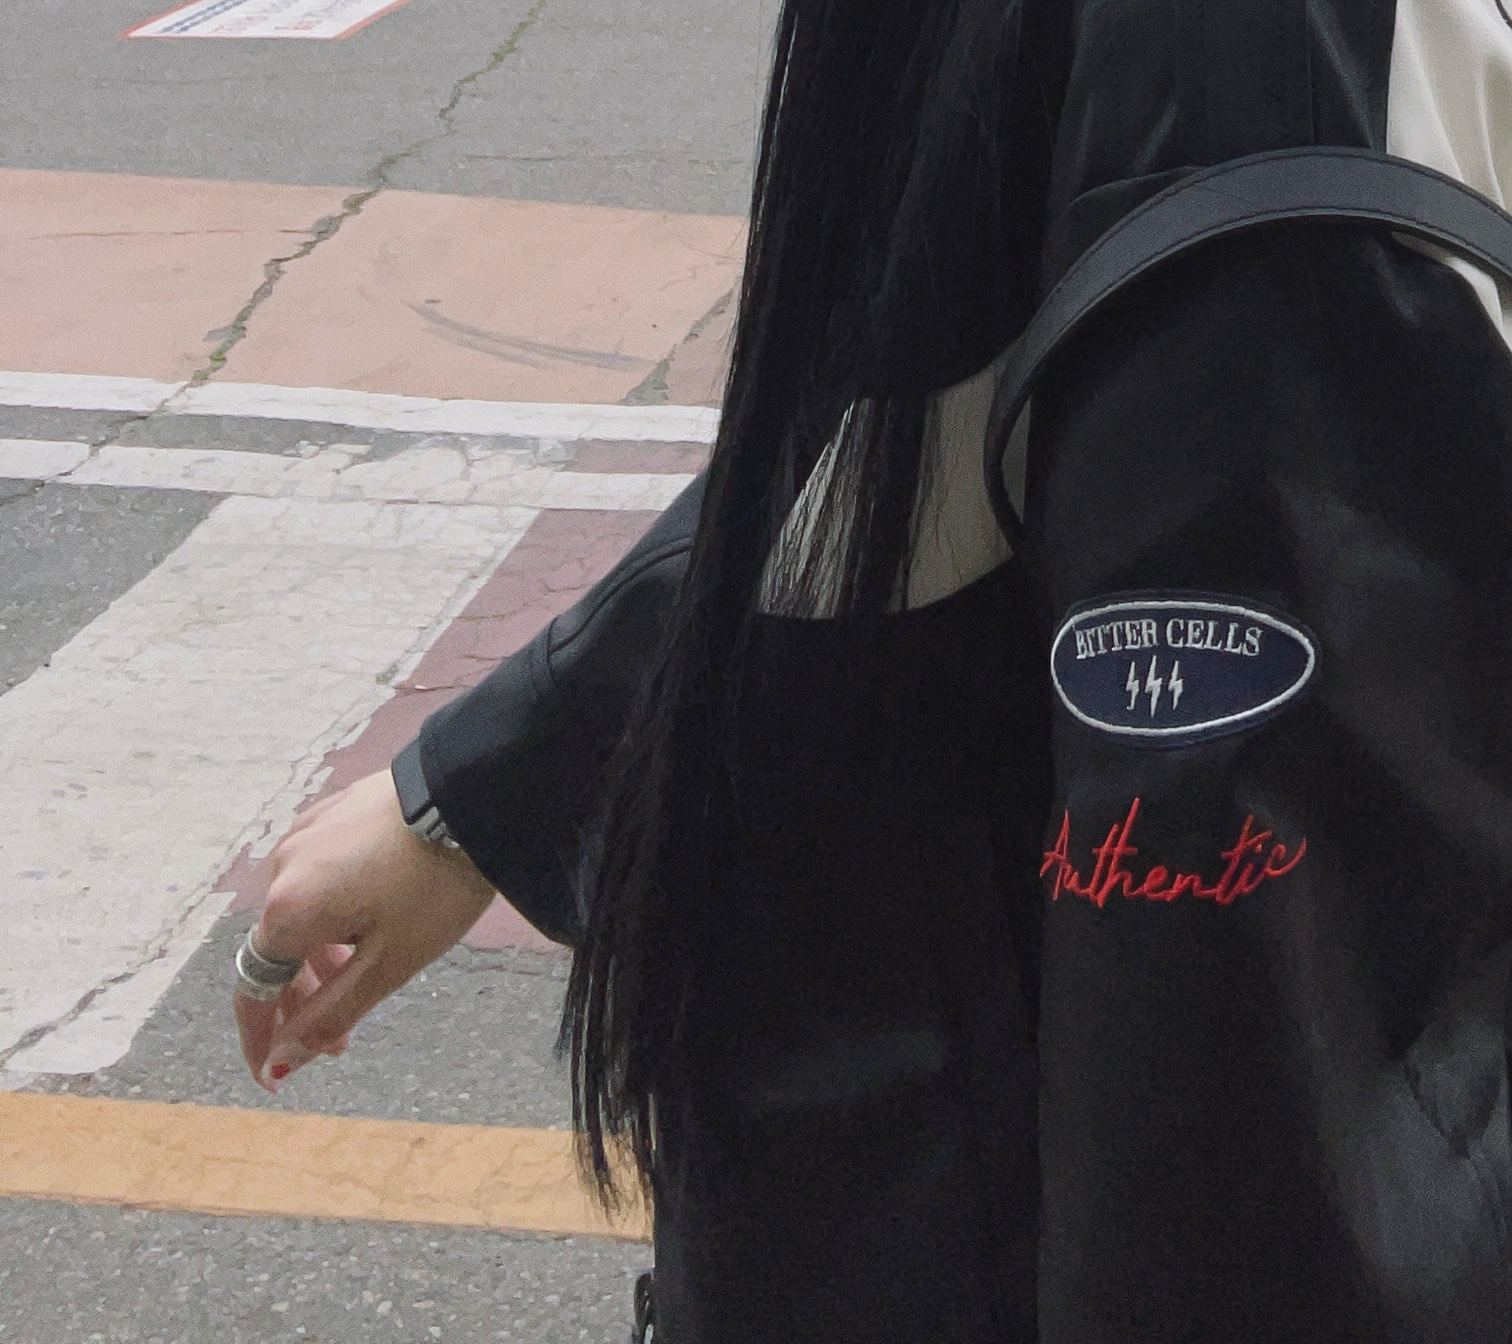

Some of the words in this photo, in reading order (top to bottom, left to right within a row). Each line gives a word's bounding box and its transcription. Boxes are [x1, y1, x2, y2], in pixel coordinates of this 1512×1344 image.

[1074, 618, 1160, 660] BITTER
[1165, 618, 1265, 657] CELLS
[1039, 796, 1308, 908] Authentic
